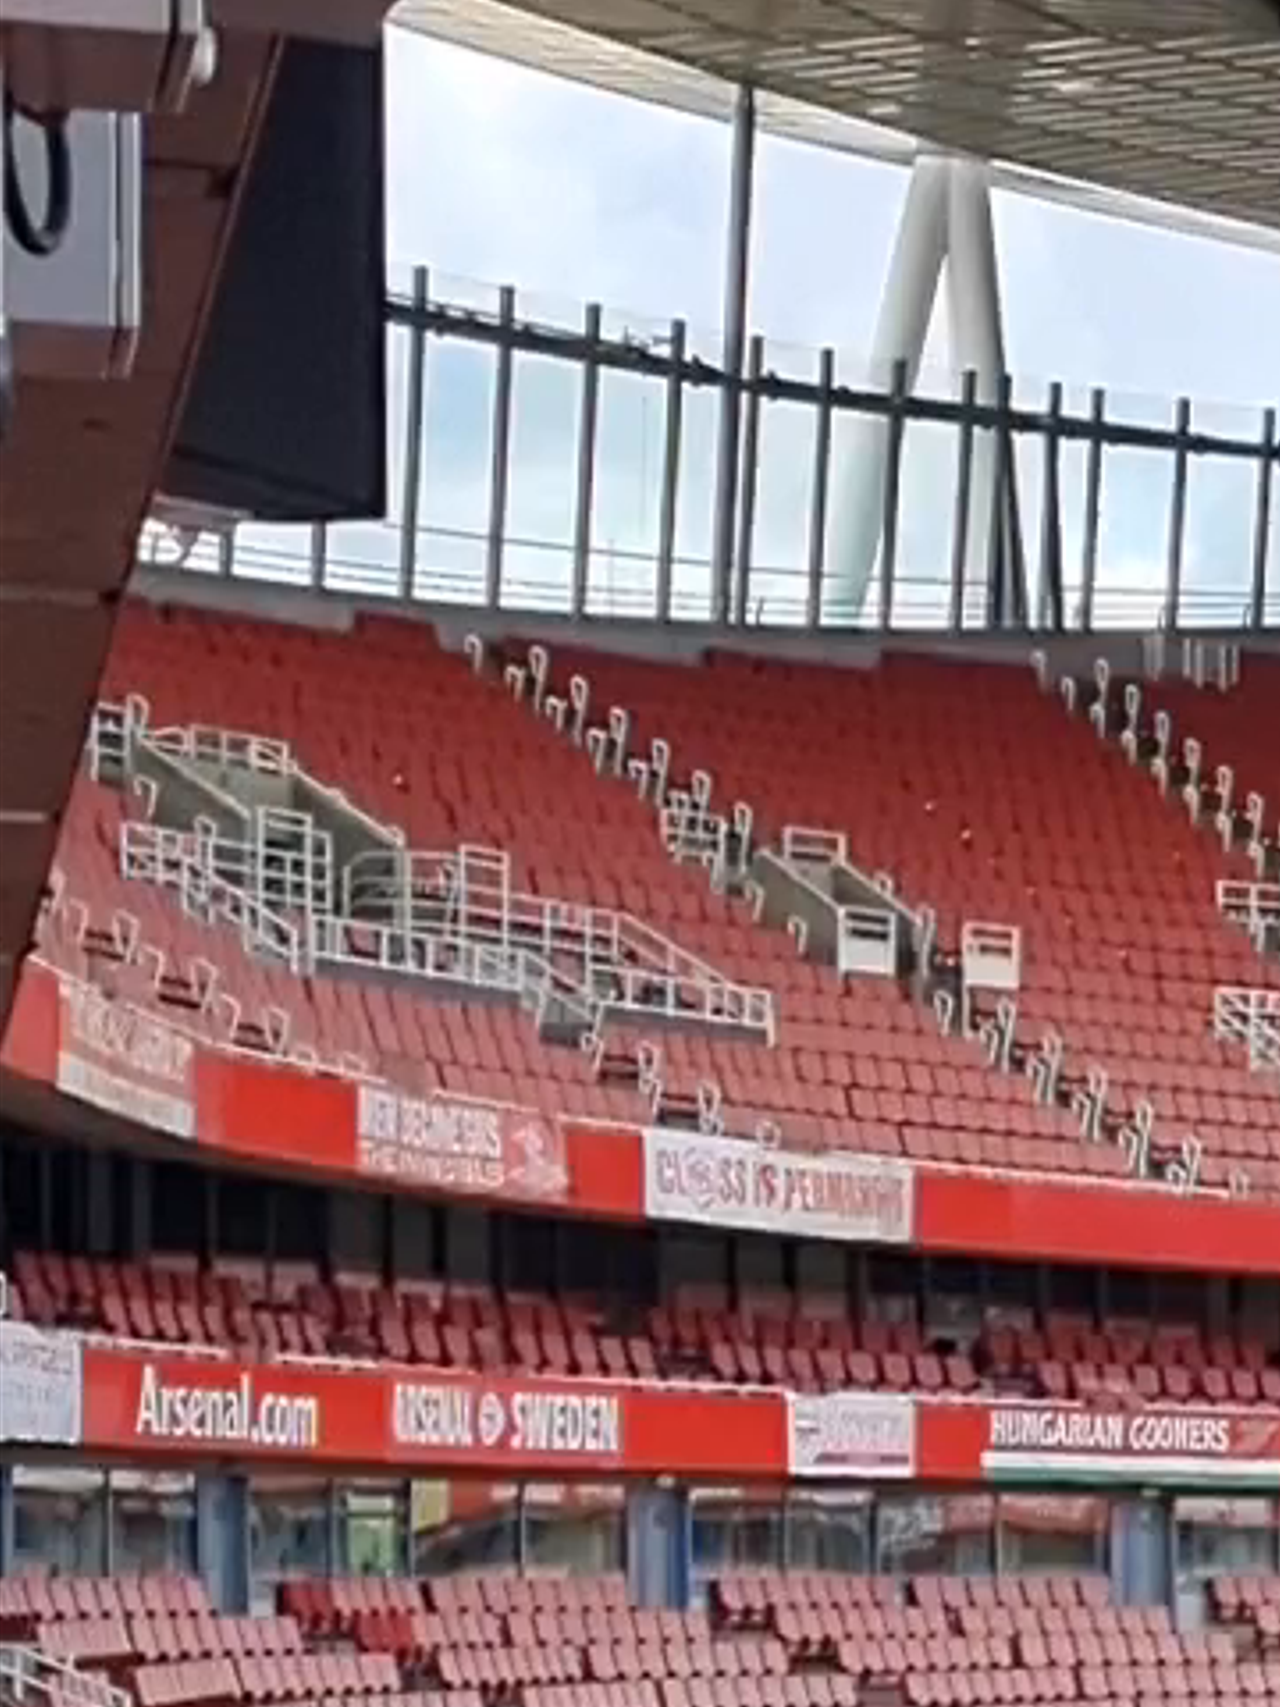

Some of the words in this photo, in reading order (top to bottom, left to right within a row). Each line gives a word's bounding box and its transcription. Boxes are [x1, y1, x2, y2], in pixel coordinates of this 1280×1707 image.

[135, 1363, 319, 1445] Arsenal.com
[510, 1392, 619, 1450] SWEDEN
[989, 1410, 1122, 1450] HUNGARIAN
[1129, 1414, 1230, 1452] GOONERS
